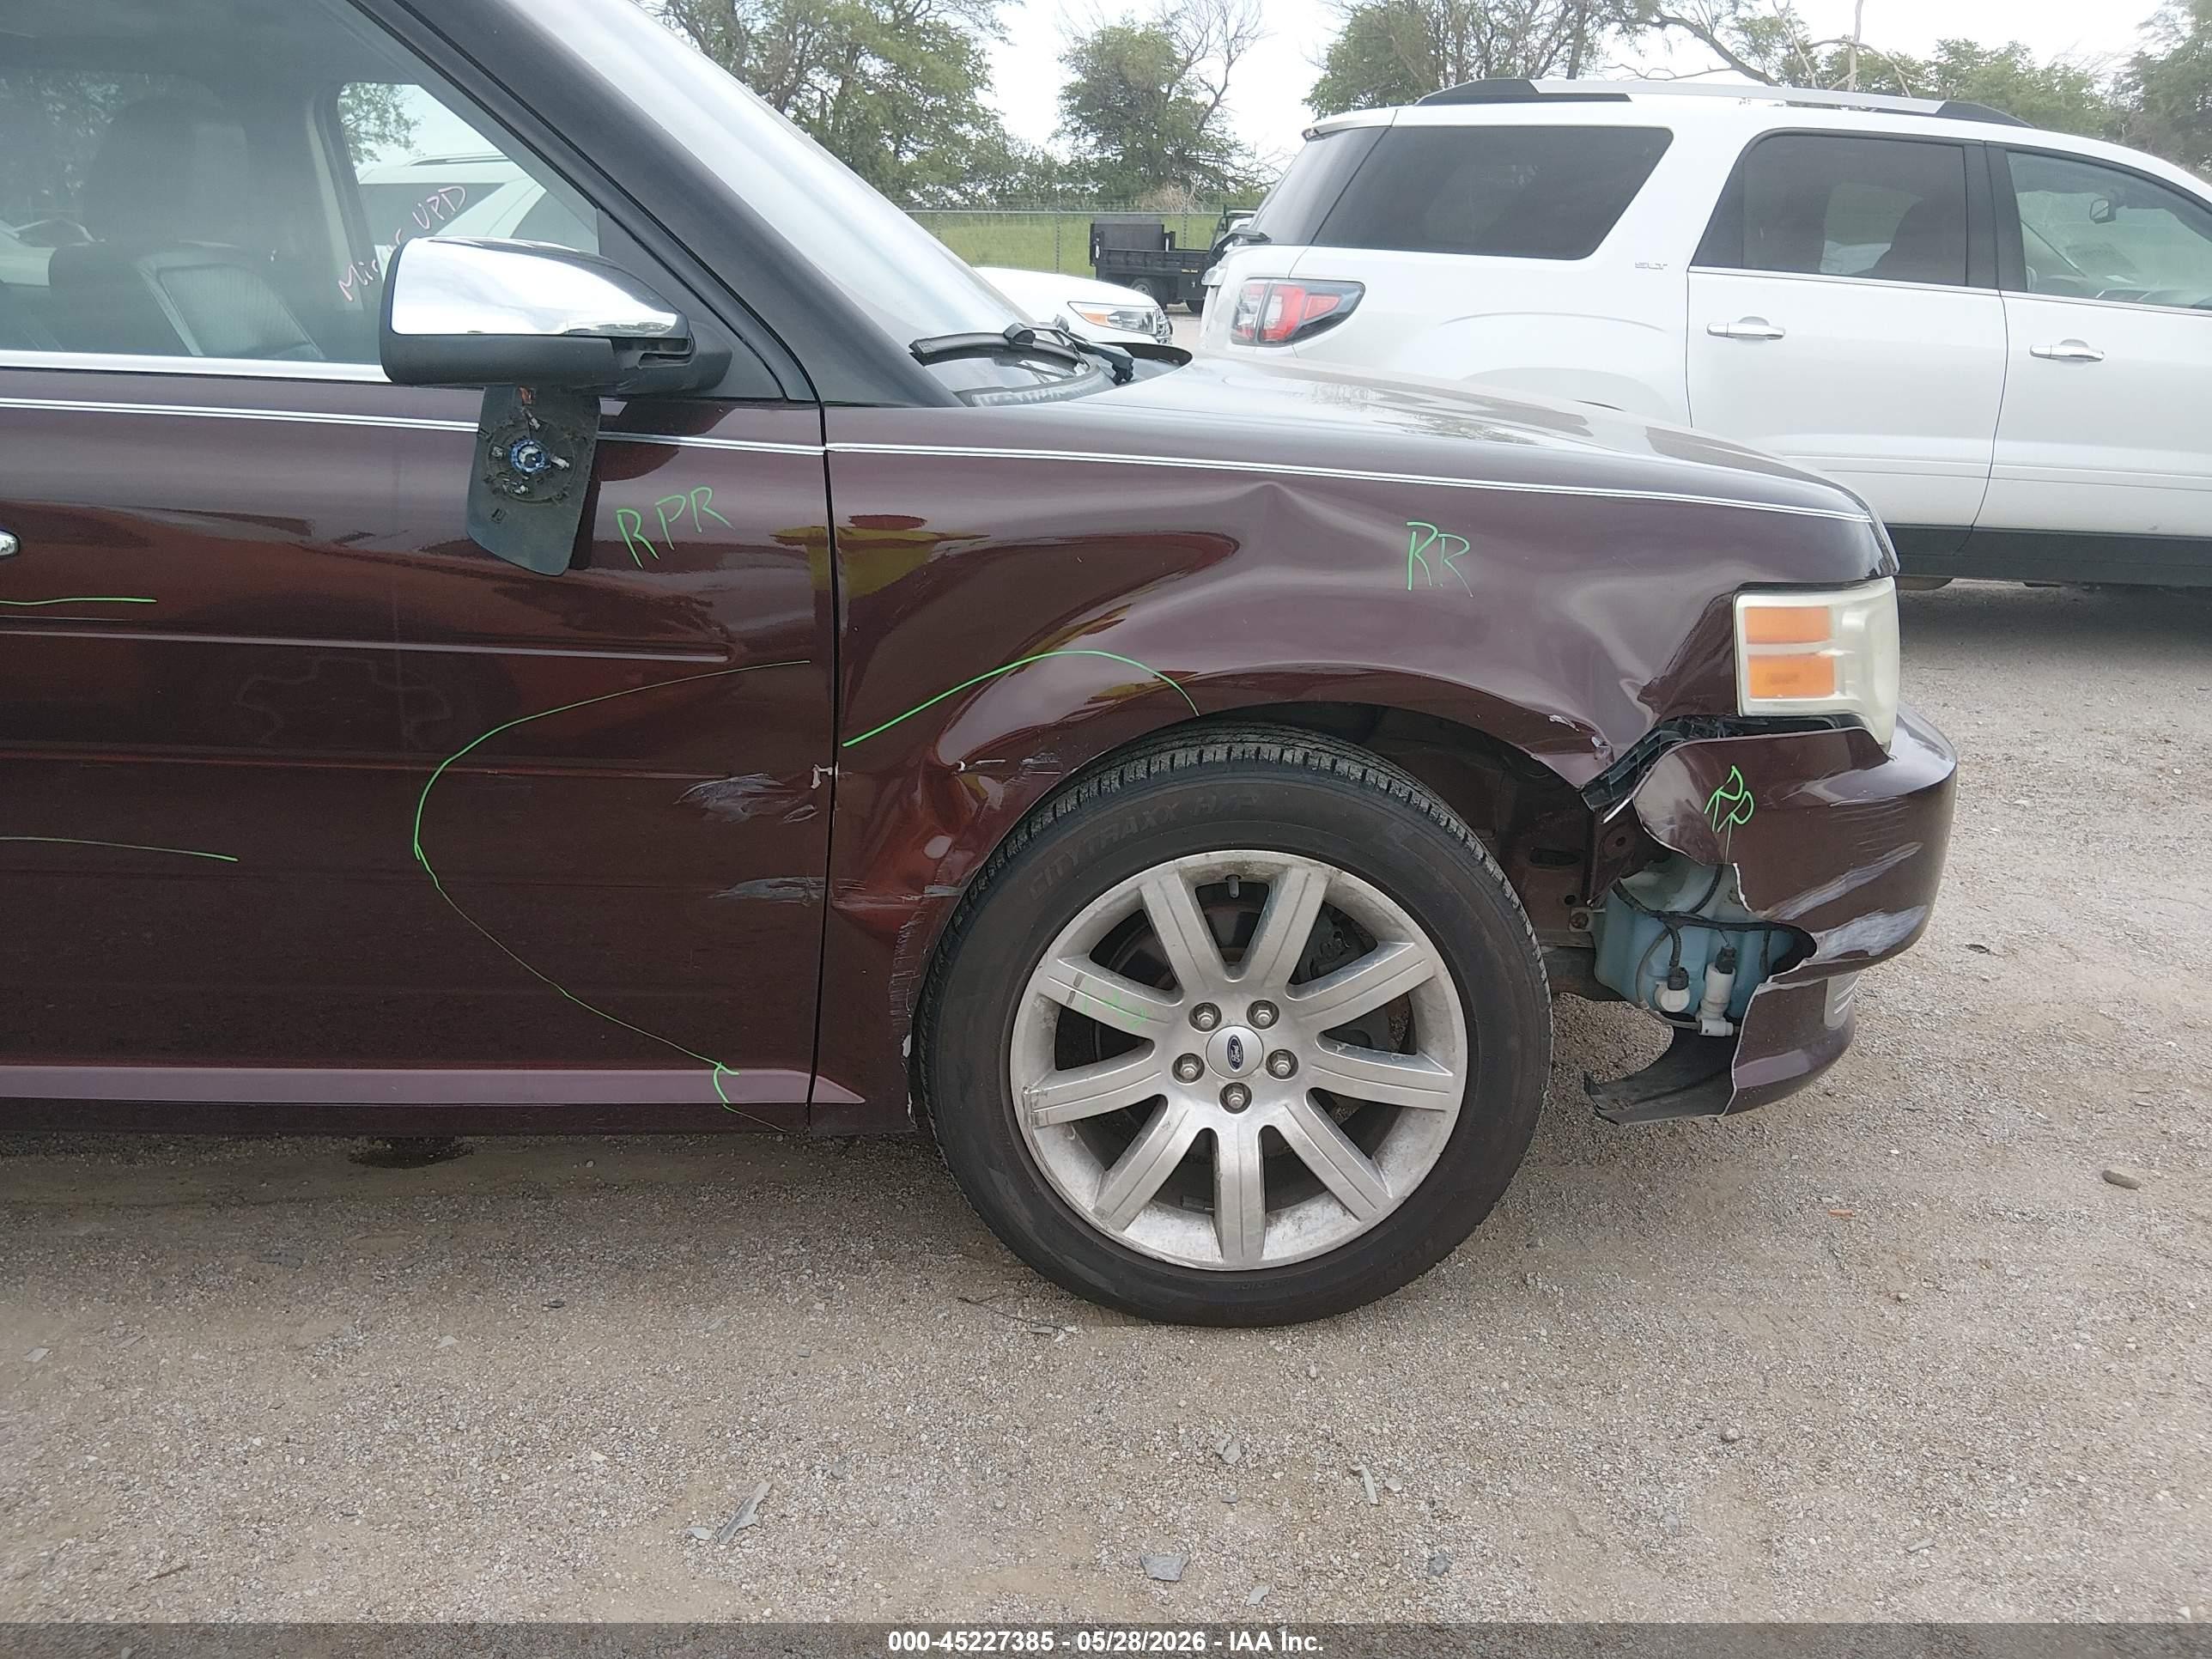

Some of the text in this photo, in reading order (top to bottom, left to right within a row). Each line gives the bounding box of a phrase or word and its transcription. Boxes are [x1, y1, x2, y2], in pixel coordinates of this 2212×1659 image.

[412, 185, 466, 229] UPD
[616, 486, 736, 569] RPR
[1407, 521, 1474, 598] RR
